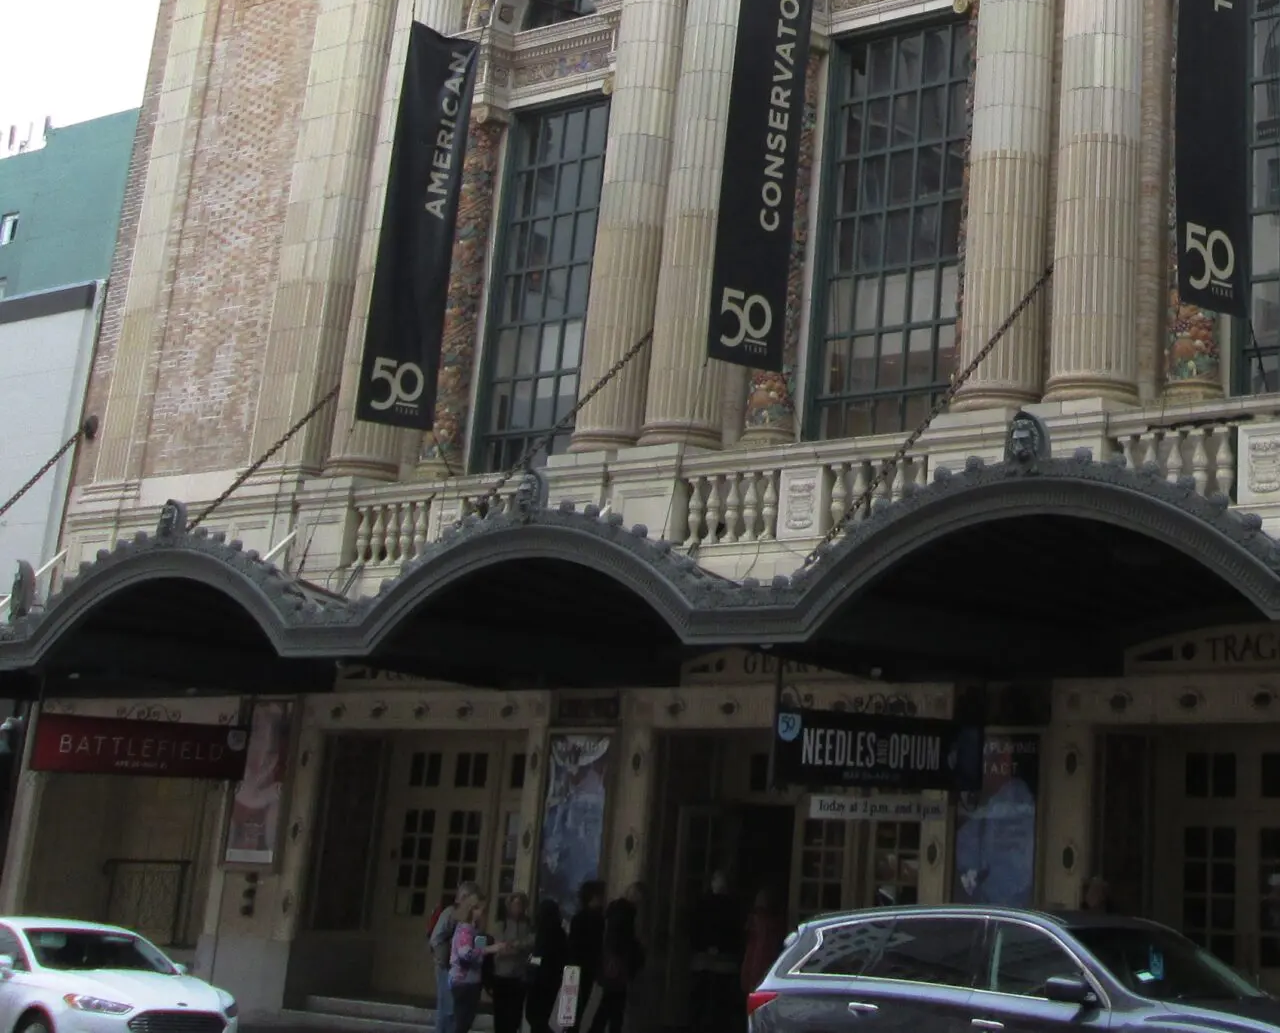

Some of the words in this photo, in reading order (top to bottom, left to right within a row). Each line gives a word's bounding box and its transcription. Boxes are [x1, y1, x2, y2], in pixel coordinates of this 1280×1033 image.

[424, 51, 468, 219] AMERICAN
[1185, 221, 1235, 290] 50
[719, 286, 772, 347] 50
[369, 356, 425, 411] 50
[59, 733, 225, 763] BATTLEFIELD
[801, 727, 876, 769] NEEDLES
[889, 732, 941, 771] OPIUM
[818, 799, 845, 816] Today
